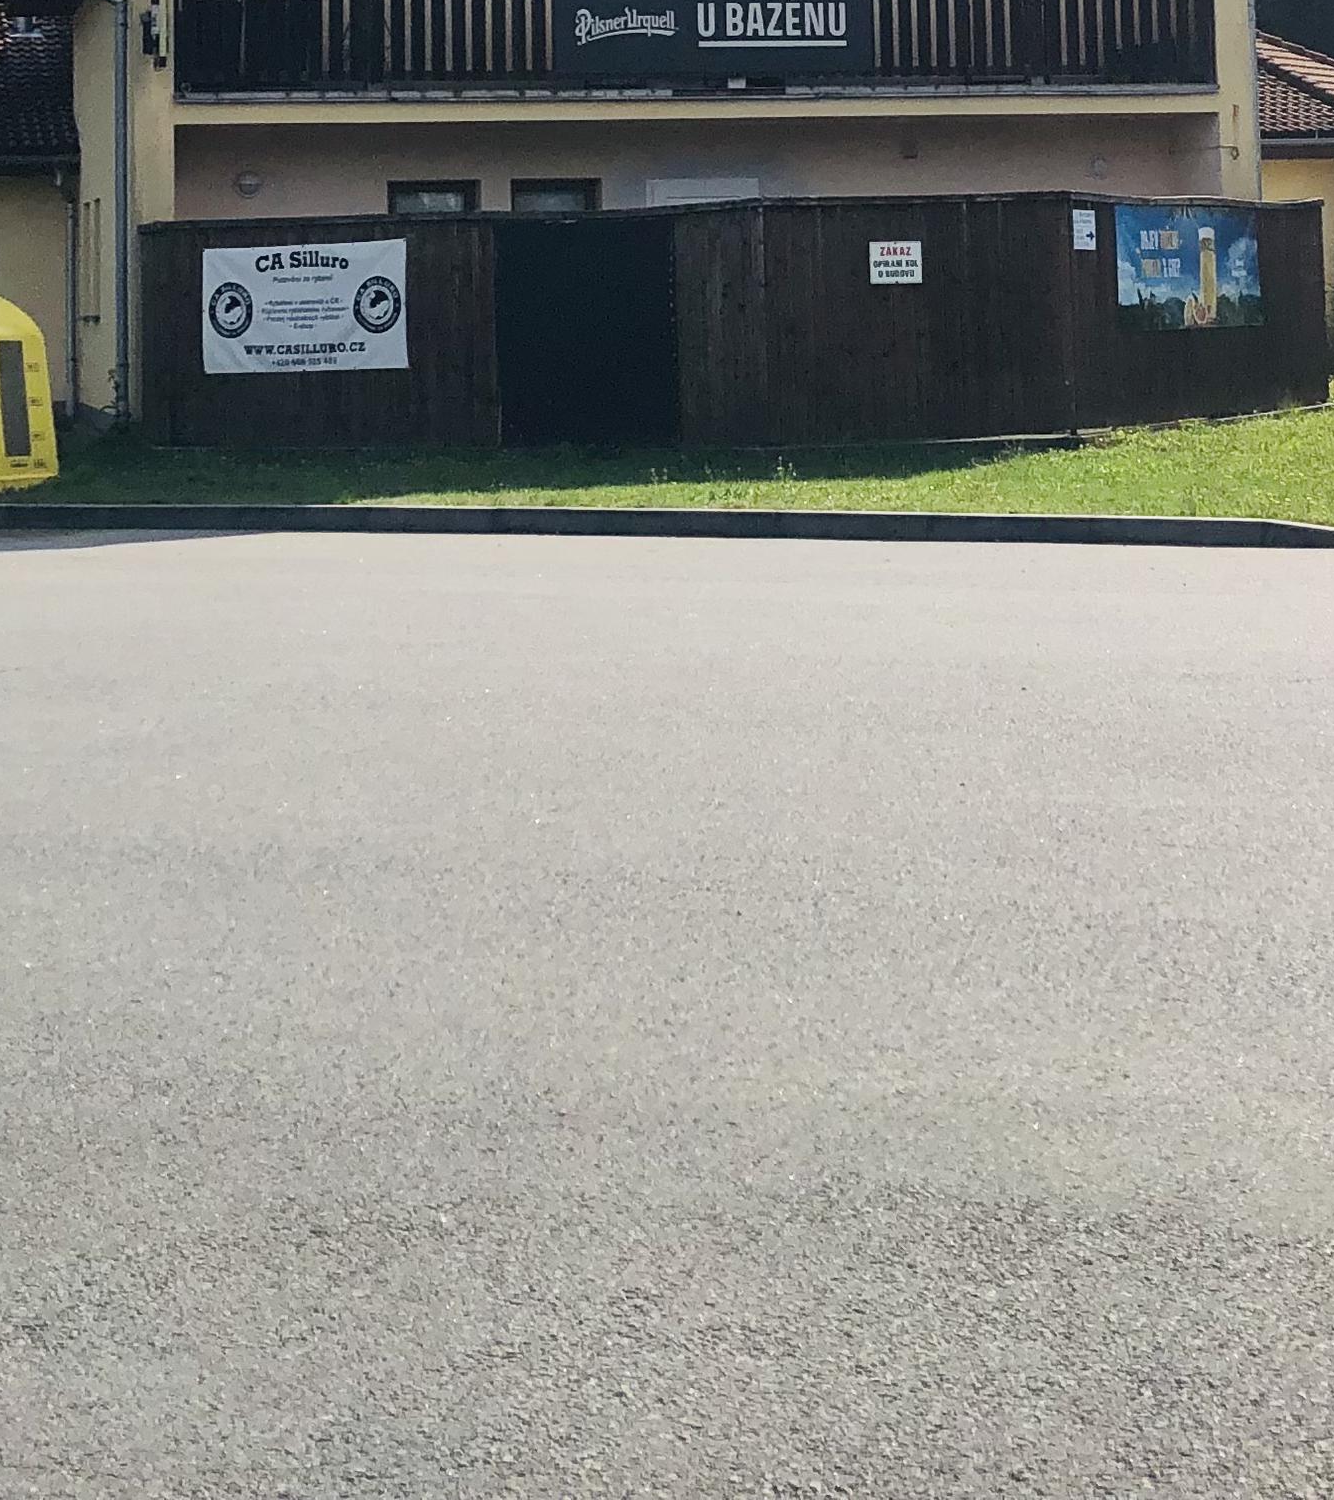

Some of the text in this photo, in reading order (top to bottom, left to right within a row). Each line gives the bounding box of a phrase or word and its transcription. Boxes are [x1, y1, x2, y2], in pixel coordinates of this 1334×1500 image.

[575, 6, 675, 46] Pilsner Urquell
[697, 2, 716, 37] U
[255, 250, 349, 273] CA Silluro
[244, 342, 366, 356] WWW.CASILLURO.CZ
